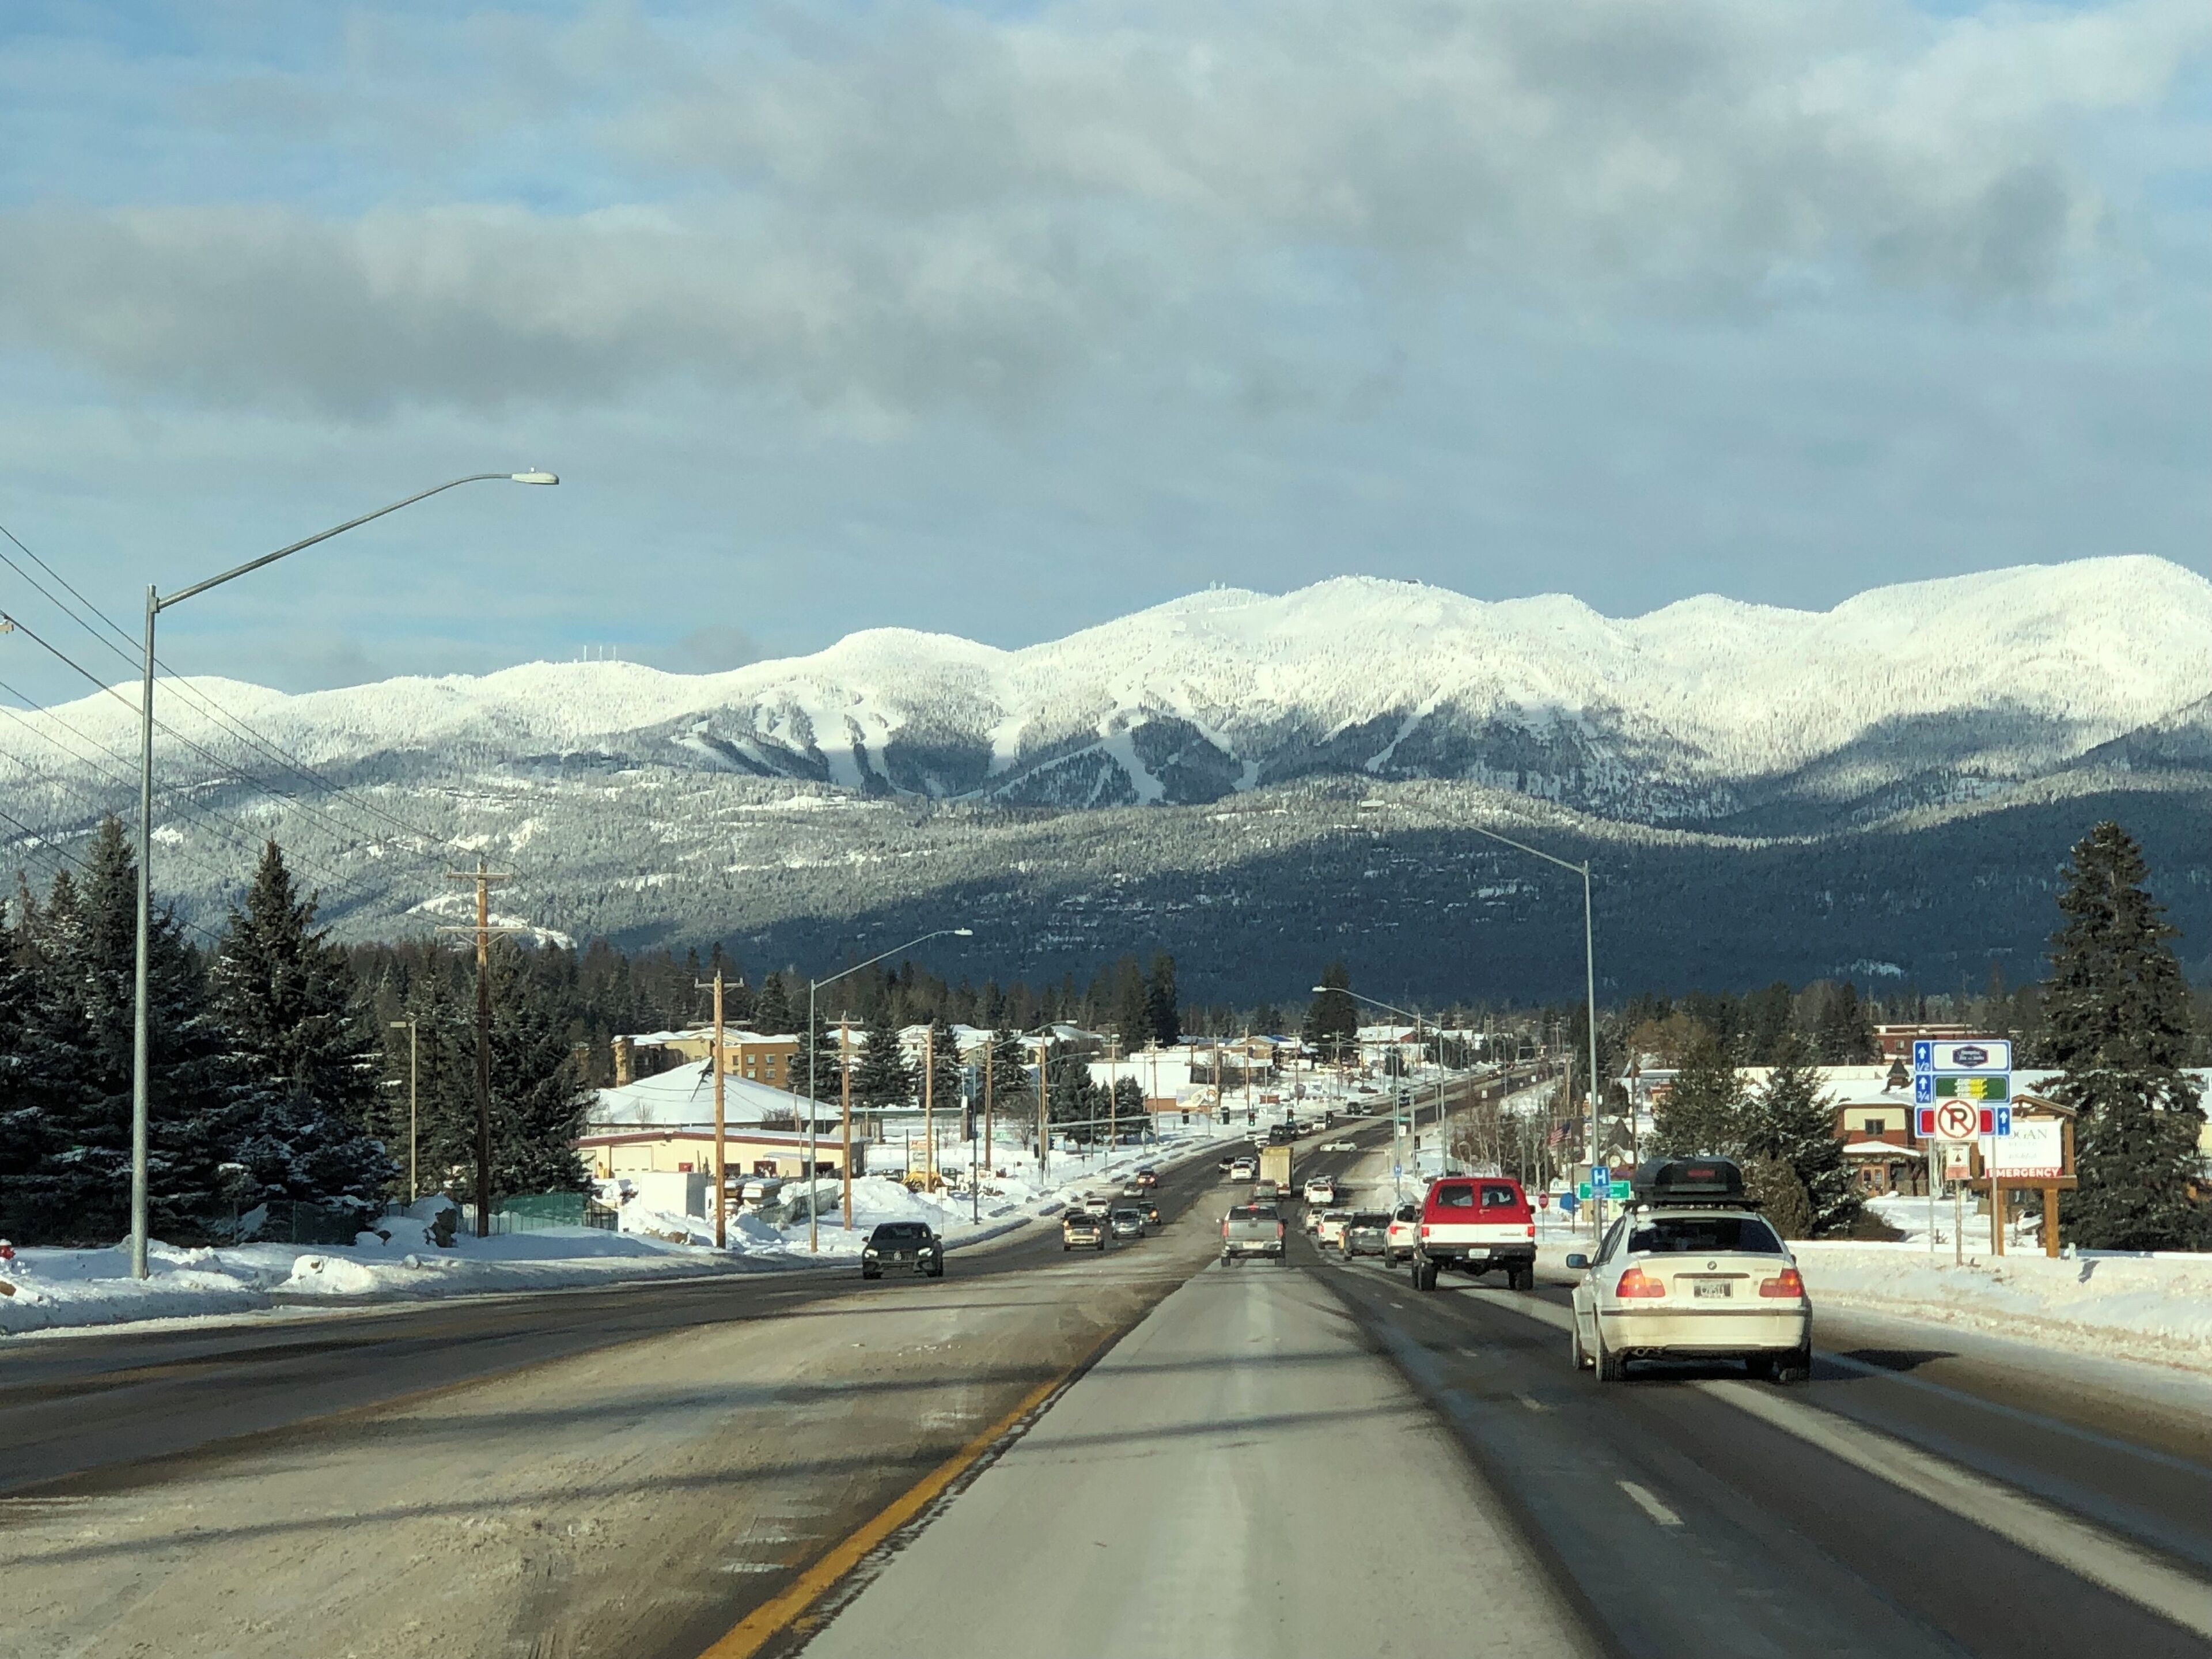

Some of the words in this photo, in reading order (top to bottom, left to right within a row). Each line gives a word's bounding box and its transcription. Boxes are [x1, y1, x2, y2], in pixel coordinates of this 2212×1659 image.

[1916, 1061, 1930, 1071] 1/2
[1917, 1090, 1930, 1102] 3/4
[1950, 1108, 1968, 1130] P
[1594, 1169, 1607, 1184] H
